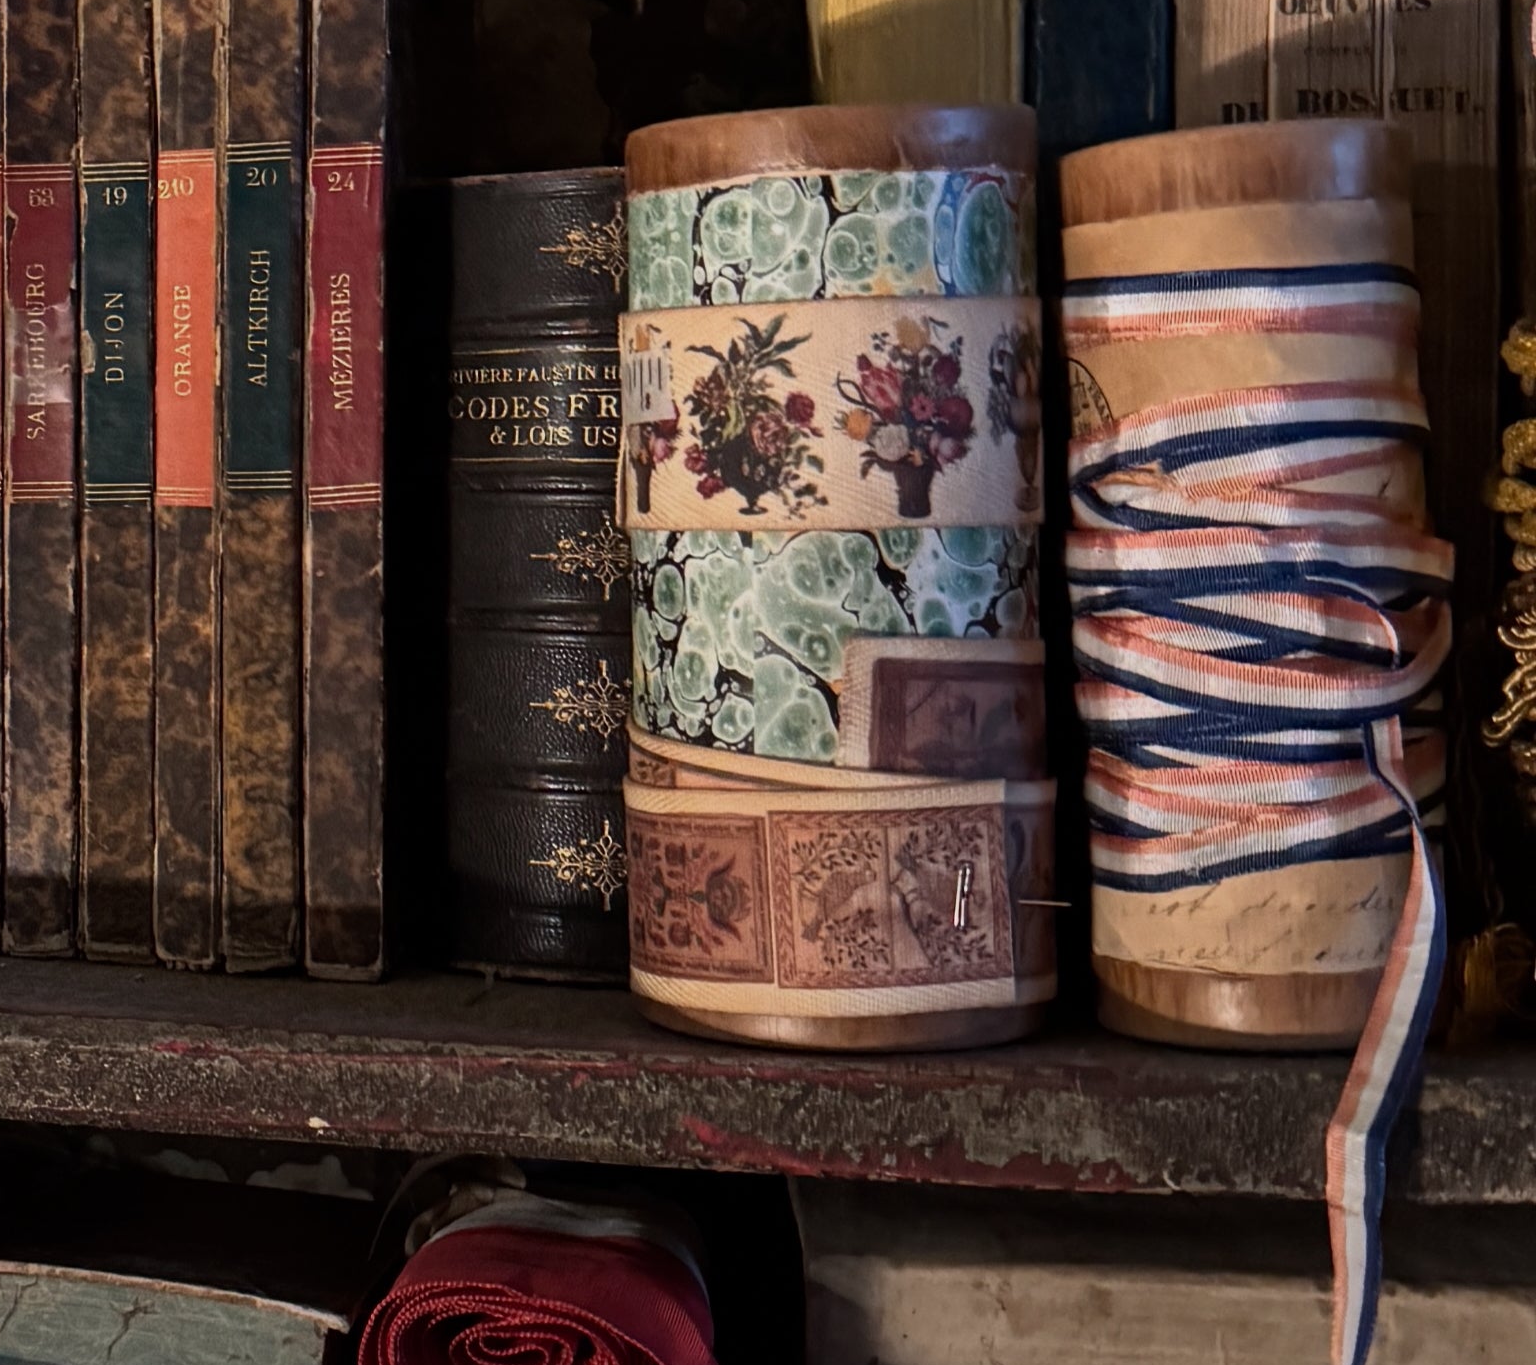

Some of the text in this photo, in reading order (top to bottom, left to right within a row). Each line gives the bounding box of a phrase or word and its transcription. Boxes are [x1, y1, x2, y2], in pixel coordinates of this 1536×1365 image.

[158, 176, 195, 200] 210
[246, 166, 277, 187] 20
[327, 171, 355, 192] 24
[102, 186, 128, 206] 19
[247, 250, 270, 387] ALTKIRCH
[104, 292, 125, 385] DIJON
[174, 284, 192, 397] ORANGE
[449, 394, 621, 421] CODES FR
[490, 425, 618, 447] & LOIS US
